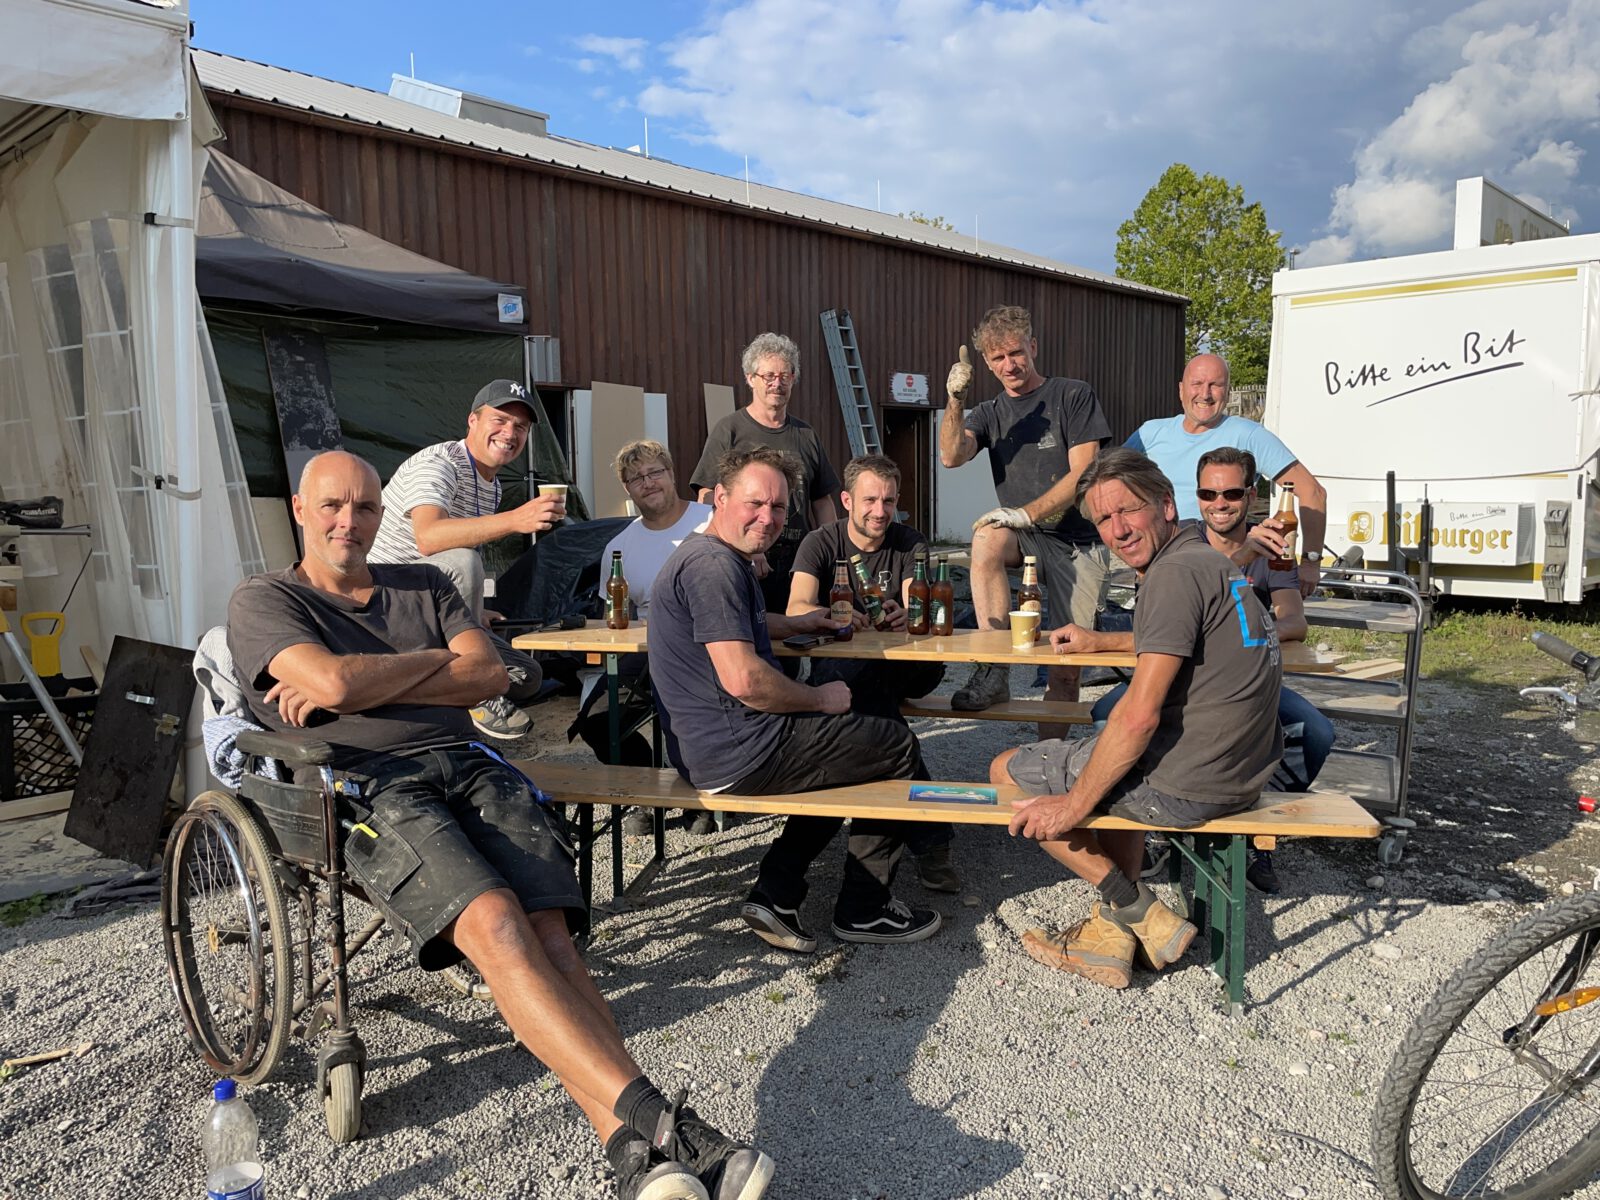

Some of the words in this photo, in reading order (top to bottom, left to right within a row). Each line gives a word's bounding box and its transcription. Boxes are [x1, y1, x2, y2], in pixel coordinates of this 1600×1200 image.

[1325, 361, 1391, 395] Bitte
[1404, 357, 1451, 377] ein
[1463, 329, 1526, 365] Bit
[509, 382, 526, 398] NY
